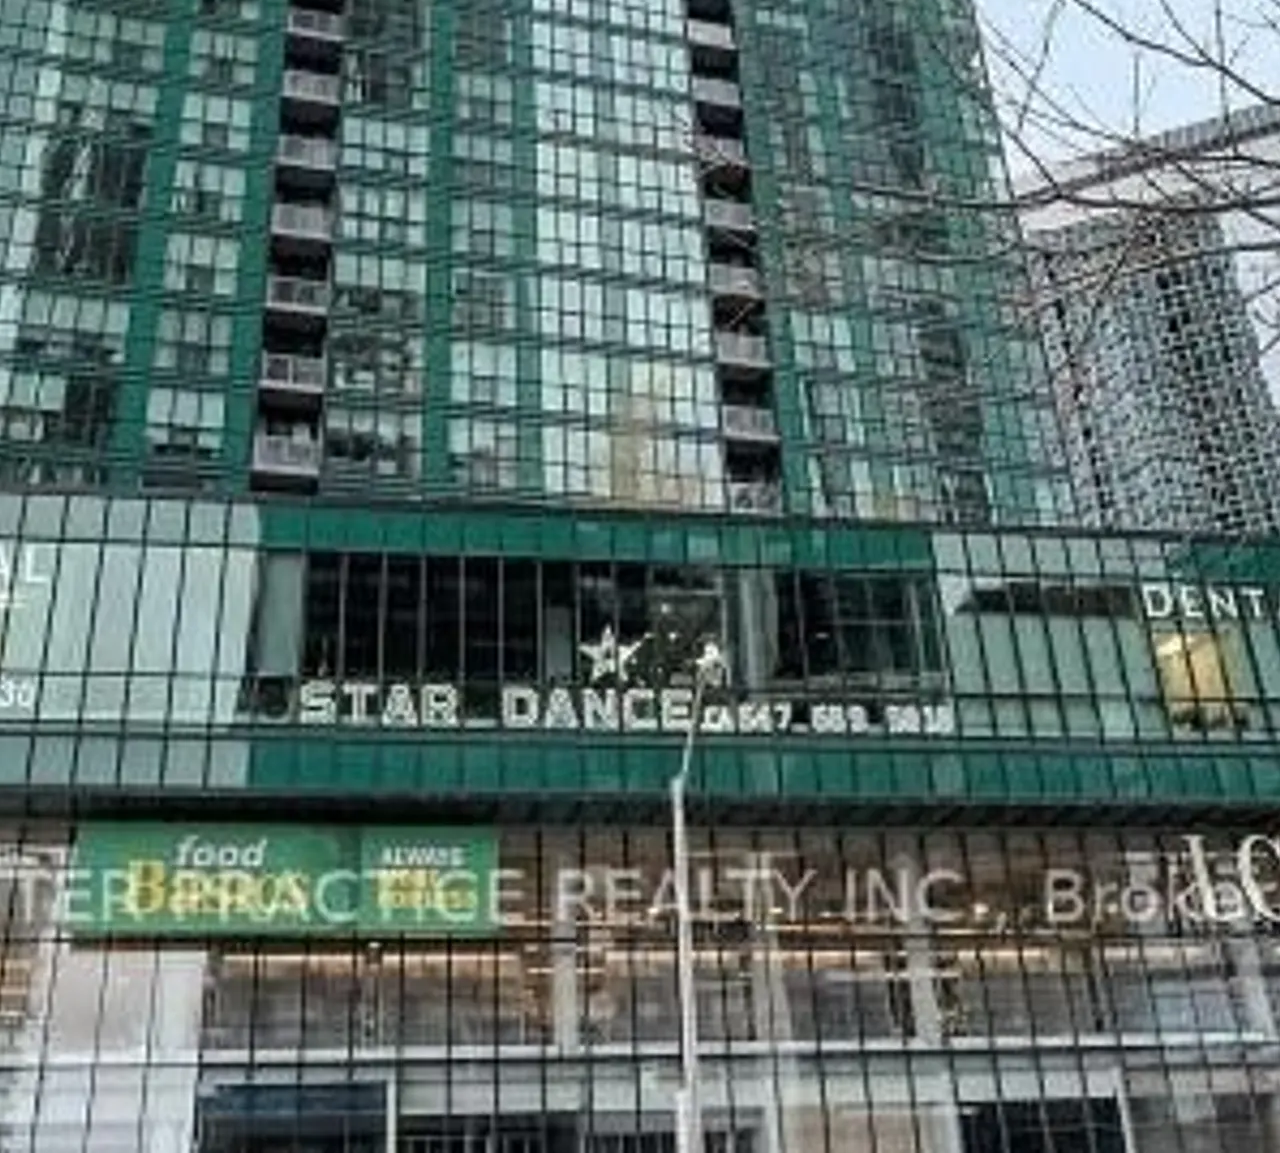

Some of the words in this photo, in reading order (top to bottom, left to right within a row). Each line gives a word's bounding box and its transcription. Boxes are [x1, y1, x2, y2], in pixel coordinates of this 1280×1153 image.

[298, 679, 460, 727] STAR
[500, 686, 694, 731] DANCE
[175, 833, 269, 867] food
